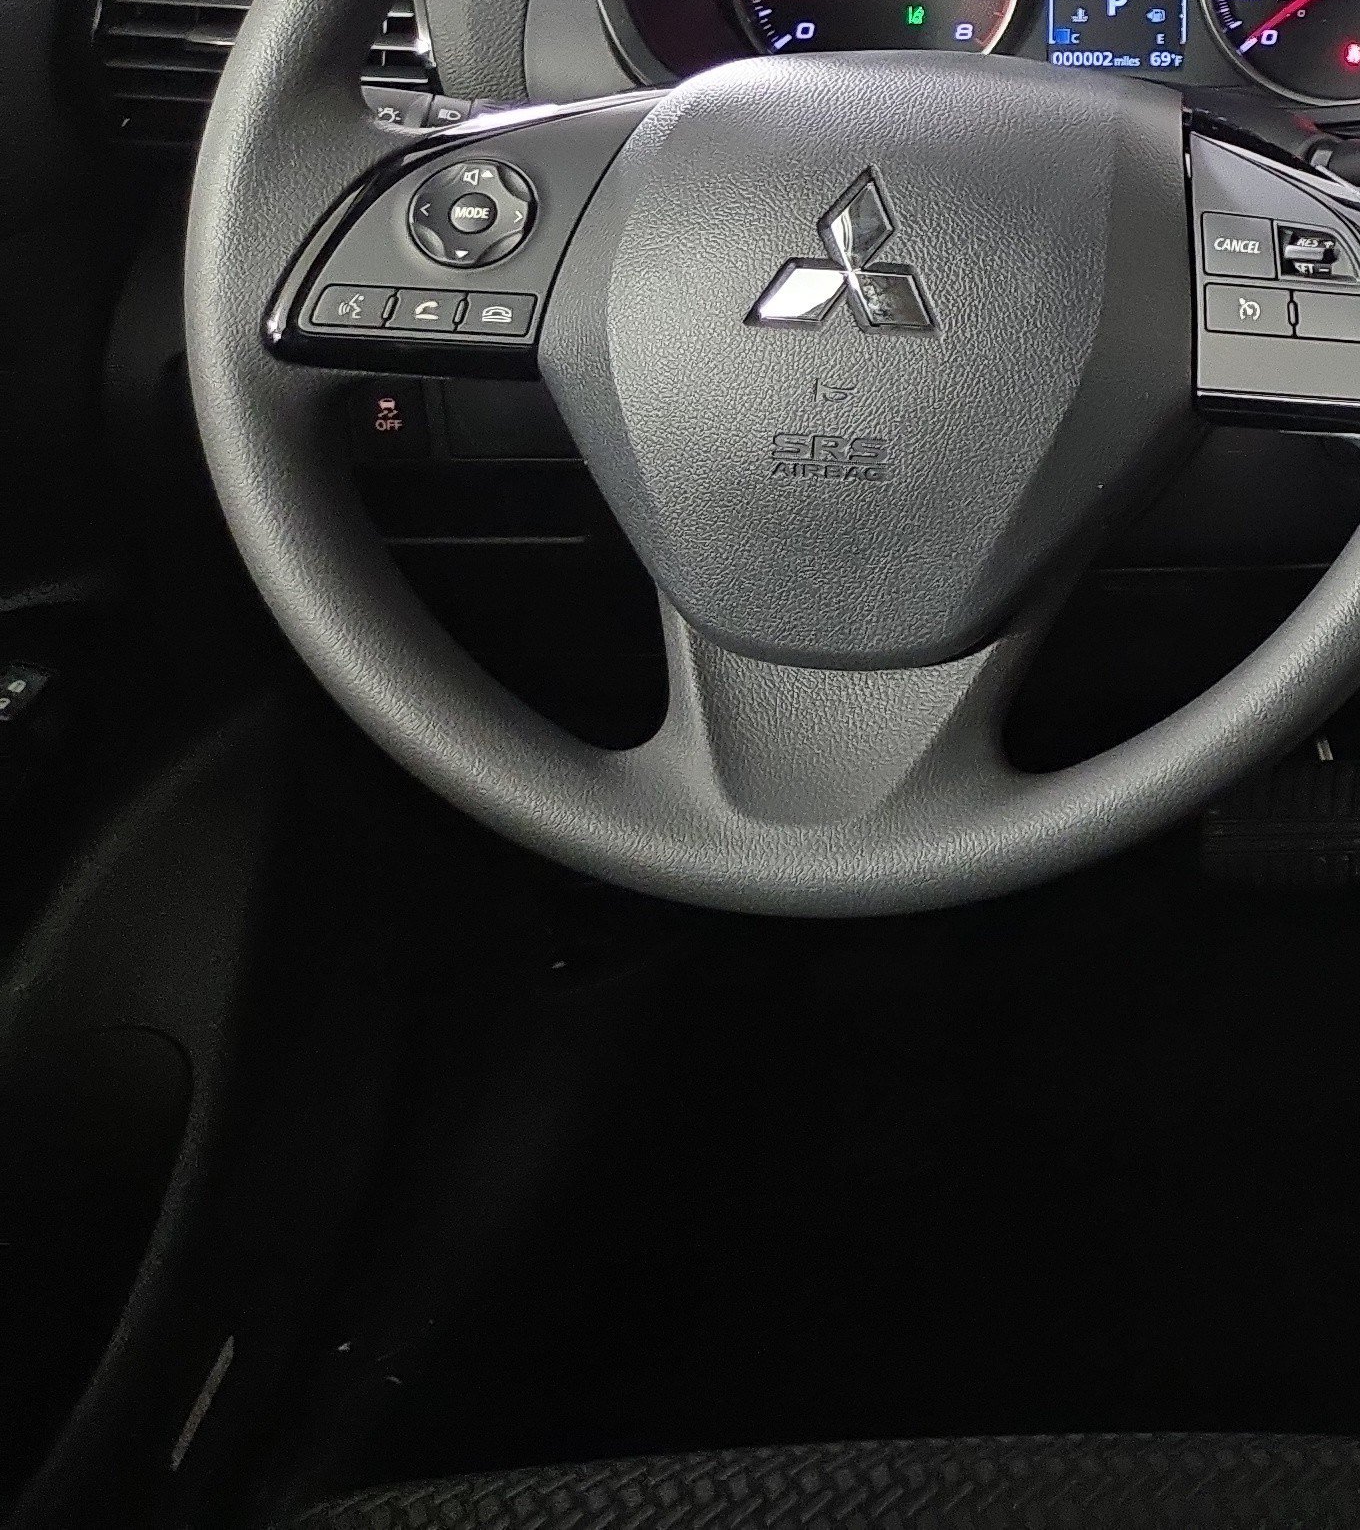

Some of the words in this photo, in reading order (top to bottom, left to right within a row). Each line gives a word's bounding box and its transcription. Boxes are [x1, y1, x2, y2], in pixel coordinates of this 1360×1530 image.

[1297, 9, 1306, 18] 0
[796, 22, 815, 40] 0
[955, 23, 973, 41] 8
[1071, 34, 1080, 44] C
[1260, 29, 1278, 45] 0
[1157, 34, 1164, 45] E
[454, 207, 490, 219] MODE
[1213, 237, 1261, 253] CANCEL
[375, 419, 403, 431] OFF
[771, 433, 888, 462] SRS
[771, 463, 887, 482] AIRBAG
